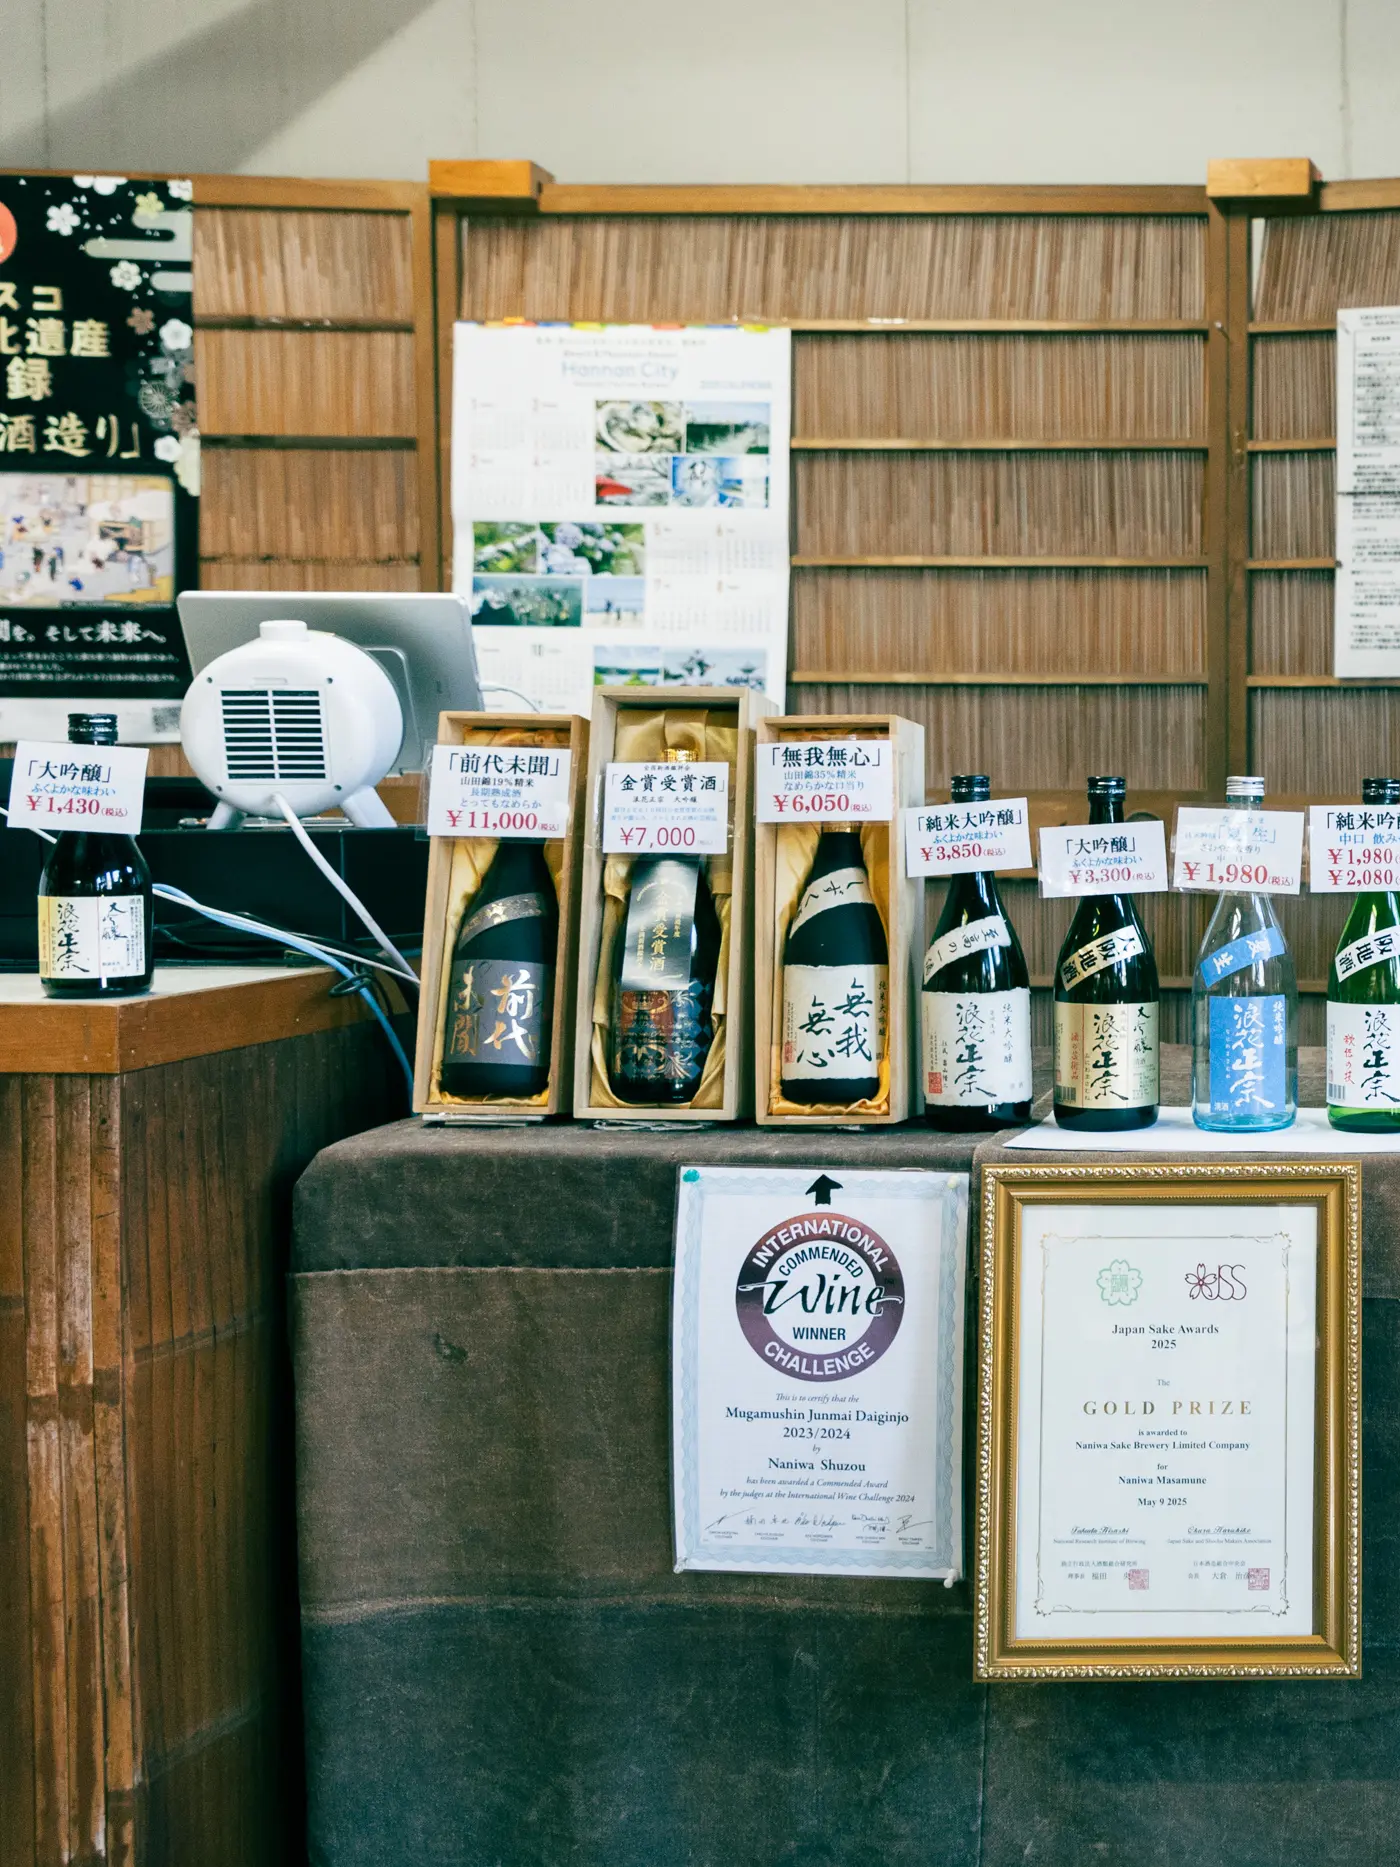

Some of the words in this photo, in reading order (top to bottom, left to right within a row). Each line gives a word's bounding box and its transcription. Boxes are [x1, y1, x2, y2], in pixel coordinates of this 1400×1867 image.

[772, 746, 881, 767] 「無我無心」
[28, 759, 112, 783] 「大吟醸」
[450, 752, 559, 777] 「前代未聞」
[32, 783, 116, 797] ふくよかな味わい
[918, 809, 1022, 832] 「純米大吟醸」
[933, 831, 1003, 844] ふくよかな味わい
[1066, 836, 1136, 855] 「大吟醸」
[1229, 1004, 1275, 1108] 浪花正宗
[1361, 1010, 1400, 1102] 浪花正宗
[752, 1219, 889, 1272] INTERNATIONAL
[778, 1246, 863, 1278] COMMENDED
[737, 1272, 903, 1316] Wine
[792, 1327, 846, 1340] WINNER
[1112, 1324, 1145, 1336] Japan
[1149, 1324, 1175, 1335] Sake
[1178, 1324, 1219, 1335] Awards
[1151, 1339, 1177, 1349] 2025
[764, 1341, 875, 1376] CHALLENGE
[1157, 1379, 1170, 1387] The
[1083, 1401, 1155, 1415] GOLD
[1172, 1401, 1252, 1415] PRIZE
[726, 1406, 805, 1422] Mugamushin
[807, 1408, 853, 1423] Junmai
[856, 1410, 909, 1426] Daiginjo
[783, 1426, 851, 1440] 2023/2024
[812, 1444, 821, 1455] by
[1076, 1441, 1108, 1449] Naniwa
[1110, 1441, 1131, 1449] Sake
[1134, 1441, 1169, 1452] Brewery
[1172, 1441, 1206, 1449] Limited
[1209, 1441, 1250, 1452] Company
[768, 1457, 815, 1471] Naniwa
[820, 1458, 866, 1472] Shuzou
[1157, 1463, 1168, 1471] for
[777, 1478, 809, 1486] awarded
[816, 1478, 862, 1488] Commended
[863, 1480, 888, 1489] Award
[1119, 1476, 1154, 1485] Naniwa
[1157, 1476, 1207, 1485] Masamune
[788, 1491, 836, 1501] International
[838, 1492, 857, 1501] Wine
[858, 1493, 894, 1504] Challenge
[896, 1494, 915, 1503] 2024
[1138, 1498, 1157, 1508] May
[1159, 1498, 1165, 1506] 9
[1167, 1498, 1187, 1506] 2025
